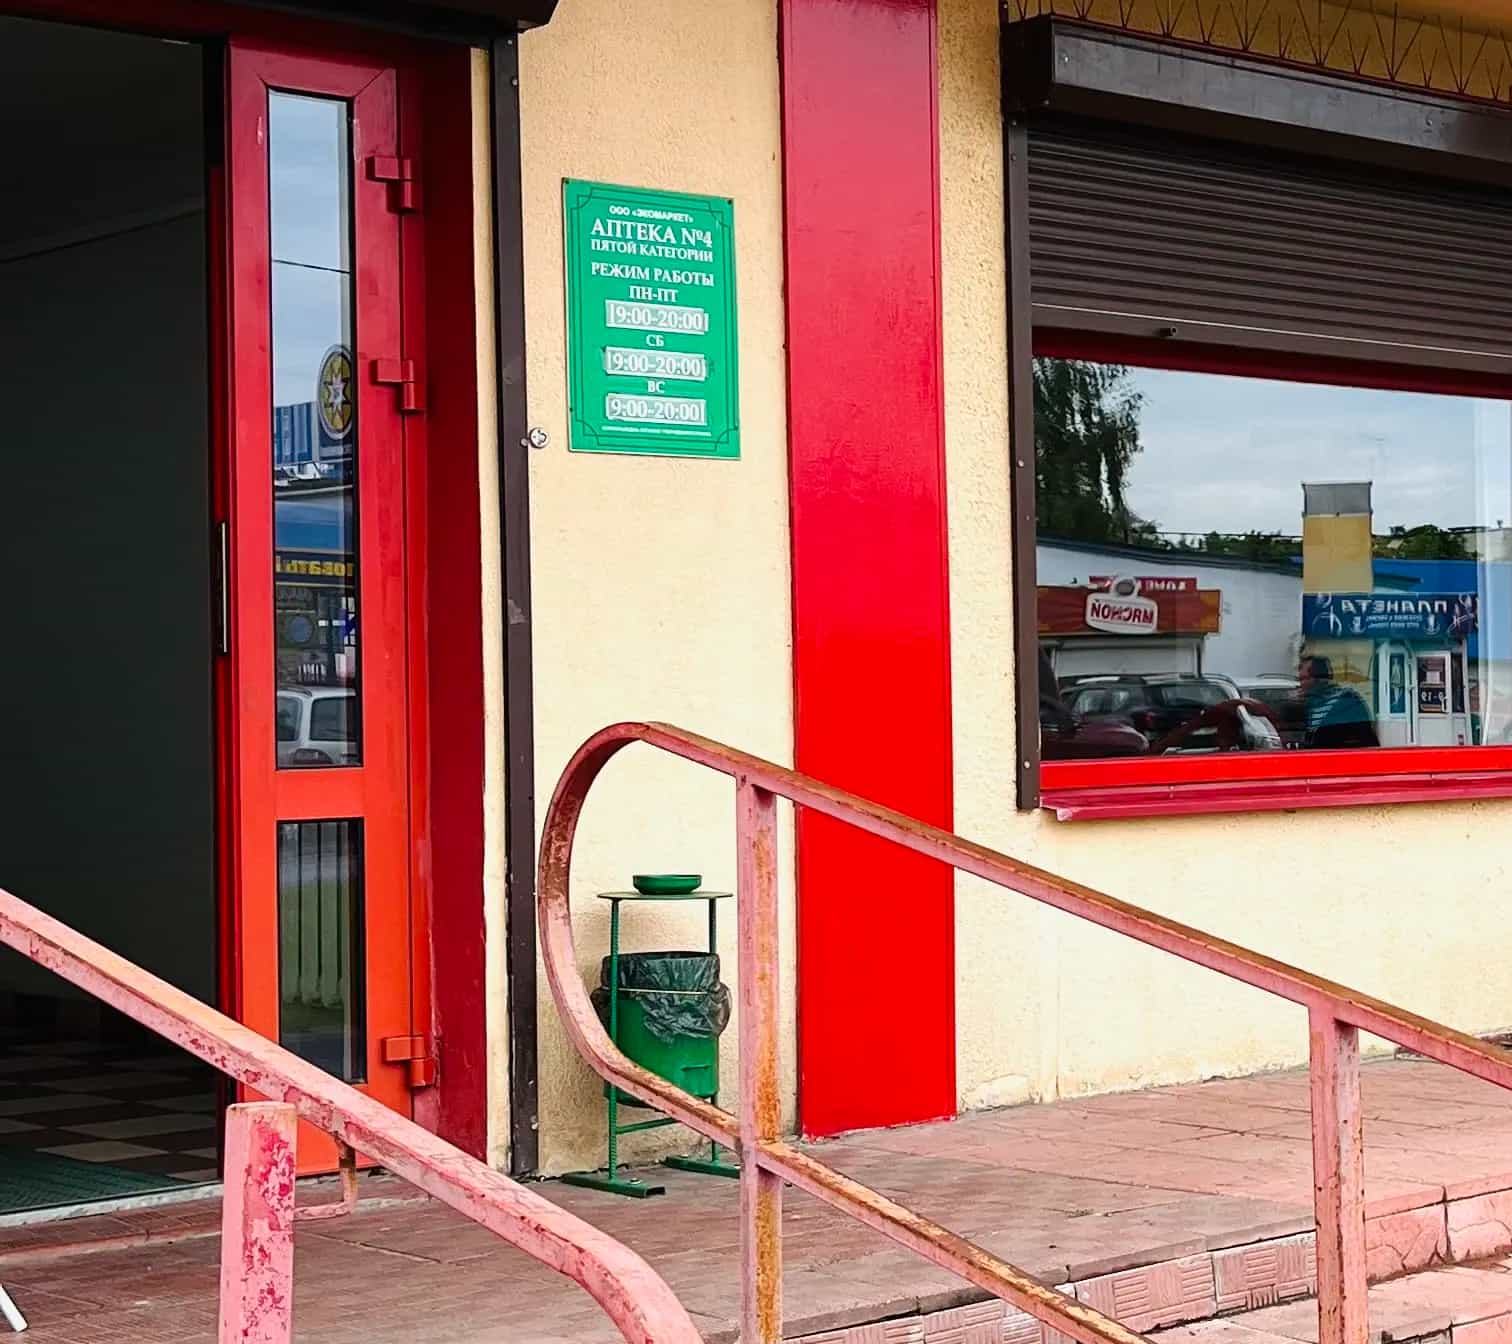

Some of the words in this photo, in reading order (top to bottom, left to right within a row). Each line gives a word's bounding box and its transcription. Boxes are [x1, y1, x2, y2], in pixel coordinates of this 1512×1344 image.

[609, 205, 630, 217] ООО
[591, 218, 677, 244] АПТЕКА
[681, 227, 713, 248] №4
[591, 238, 637, 255] ПЯТОЙ
[639, 244, 714, 263] КАТЕГОРИИ
[591, 262, 650, 282] РЕЖИМ
[653, 268, 715, 288] РАБОТЫ
[629, 285, 679, 303] ПН-ПТ
[614, 307, 701, 331] 9:00-20:00
[645, 334, 665, 348] СБ
[613, 352, 700, 377] 9:00-20:00
[647, 380, 666, 394] ВС
[611, 399, 700, 423] 9:00-20:00
